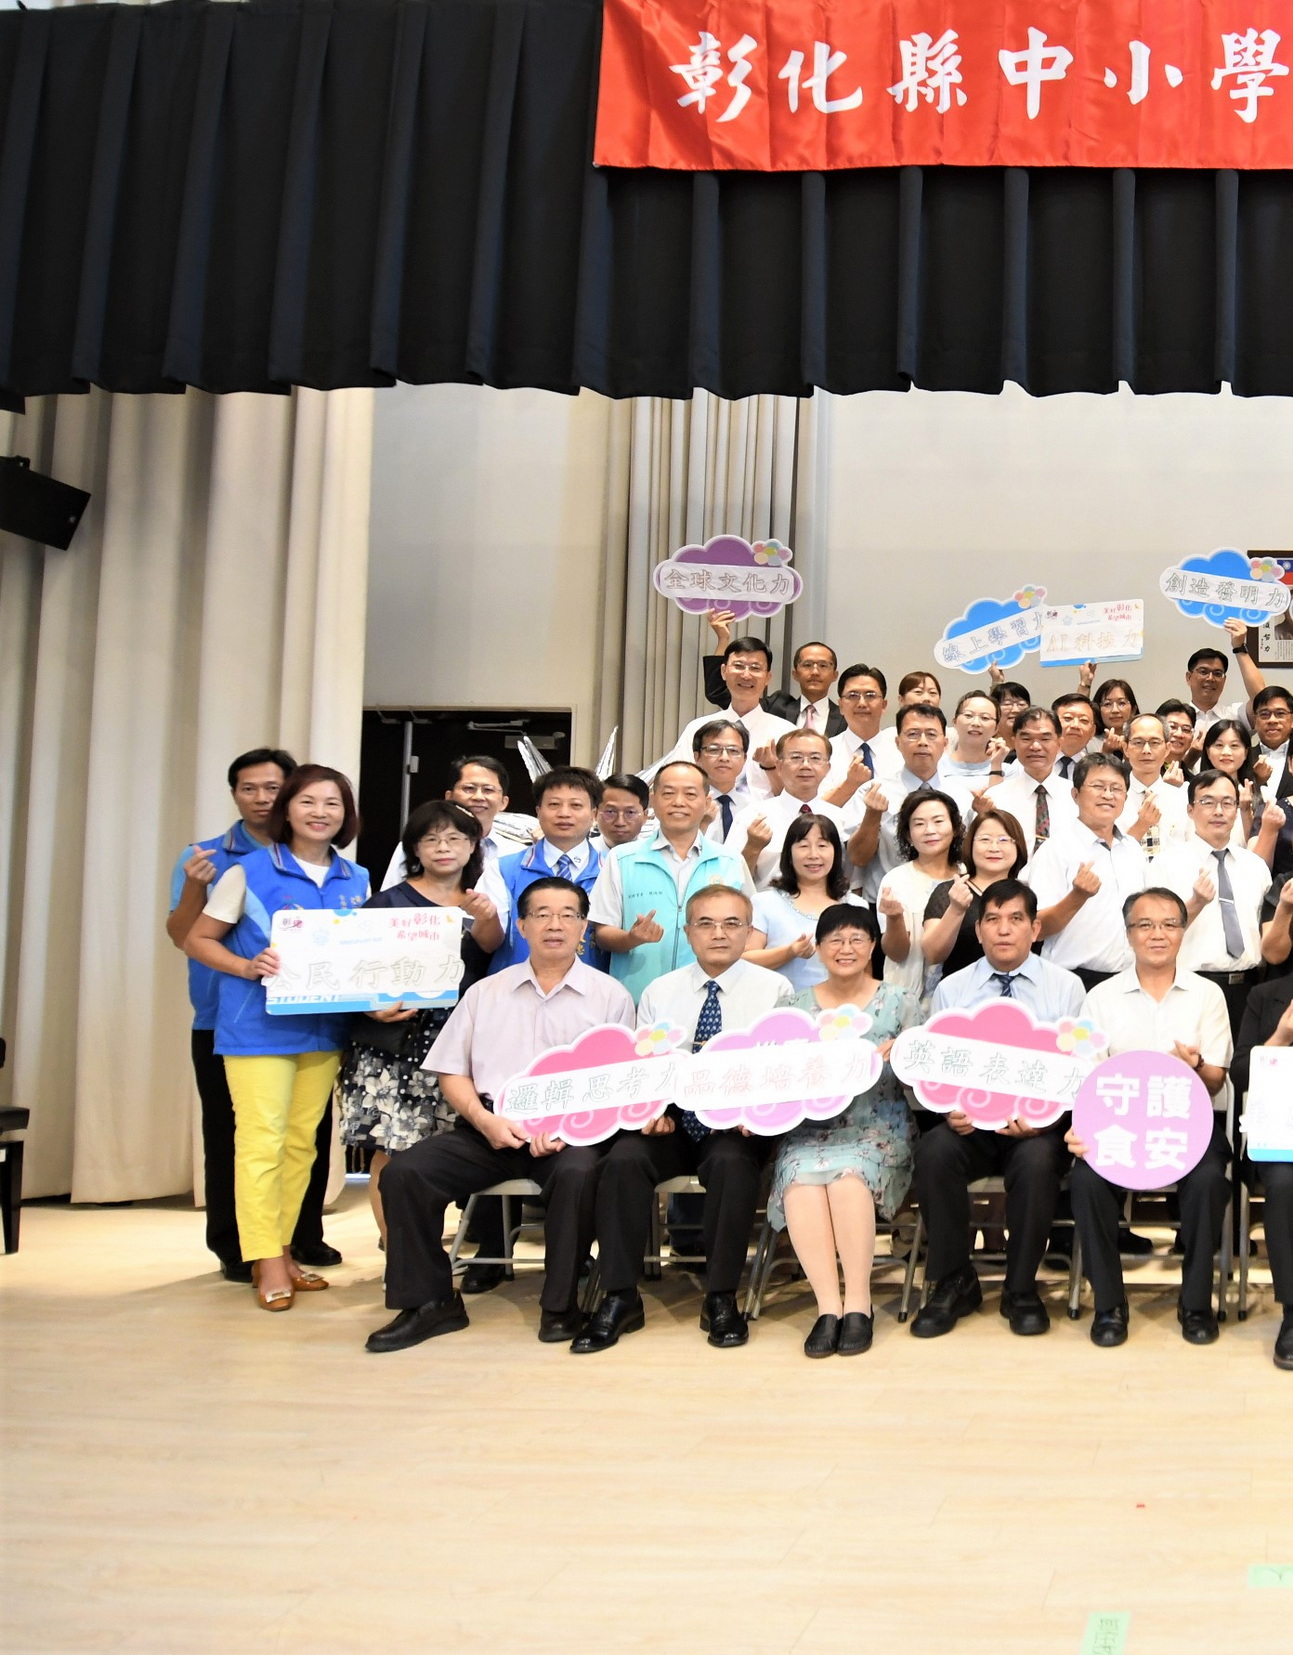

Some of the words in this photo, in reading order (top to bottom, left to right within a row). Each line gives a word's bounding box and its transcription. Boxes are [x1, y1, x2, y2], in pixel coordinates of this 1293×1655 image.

[664, 568, 790, 596] 全球文化力
[1165, 572, 1285, 608] 創造發明力
[683, 1052, 870, 1098] 品德培養力
[903, 1038, 1086, 1099] 英語表達力
[1095, 1072, 1193, 1120] 守護
[1094, 1123, 1189, 1172] 食安
